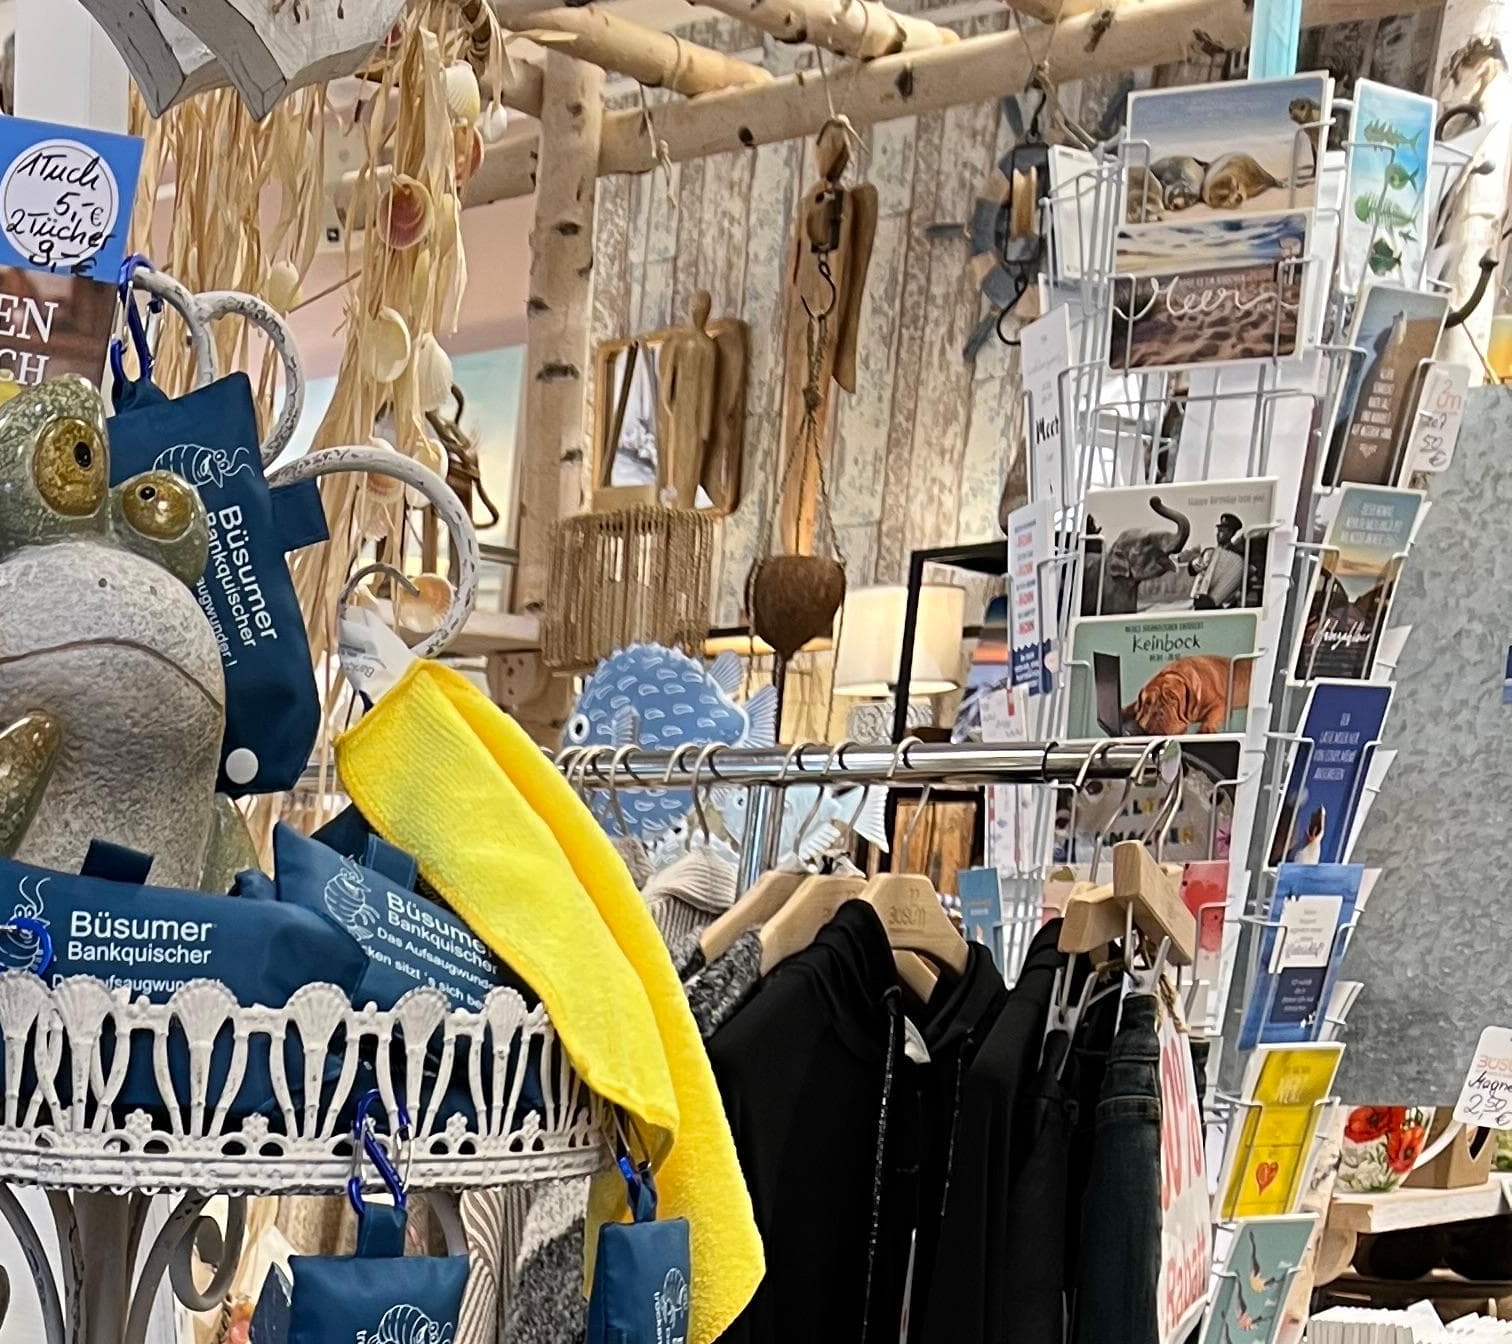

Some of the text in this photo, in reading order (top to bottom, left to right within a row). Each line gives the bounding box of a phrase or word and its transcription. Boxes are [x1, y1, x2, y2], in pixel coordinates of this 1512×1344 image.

[218, 505, 277, 640] Büsumer
[71, 911, 213, 942] Büsumer
[68, 941, 211, 966] Bankquischer
[377, 927, 494, 990] Das Aufsaugwund
[435, 983, 464, 1001] sich
